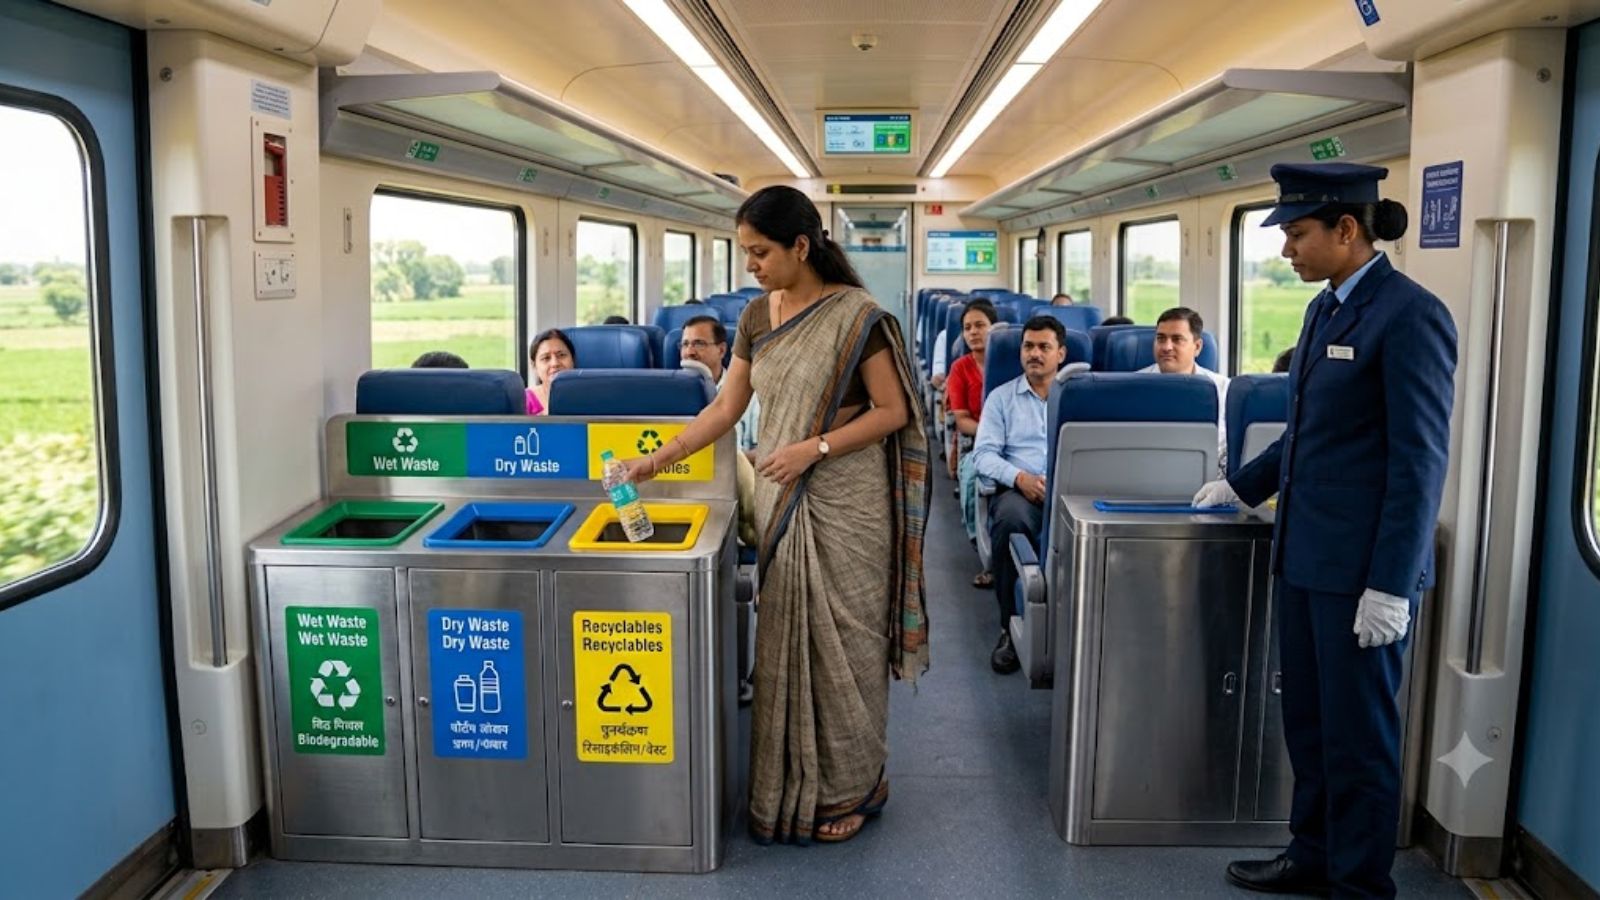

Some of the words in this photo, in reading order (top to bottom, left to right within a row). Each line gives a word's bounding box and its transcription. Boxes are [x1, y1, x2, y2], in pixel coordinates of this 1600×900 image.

[373, 456, 397, 471] Wet
[401, 457, 440, 471] Waste
[495, 458, 517, 476] Dry
[521, 459, 560, 473] Waste
[297, 613, 324, 628] Wet
[326, 614, 367, 629] Waste
[441, 616, 465, 634] Dry
[467, 617, 510, 632] Waste
[582, 619, 662, 636] Recyclables
[327, 632, 368, 647] Waste
[442, 635, 466, 652] Dry
[468, 635, 510, 650] Waste
[583, 637, 663, 654] Recyclables
[298, 733, 379, 749] Biodegradable
